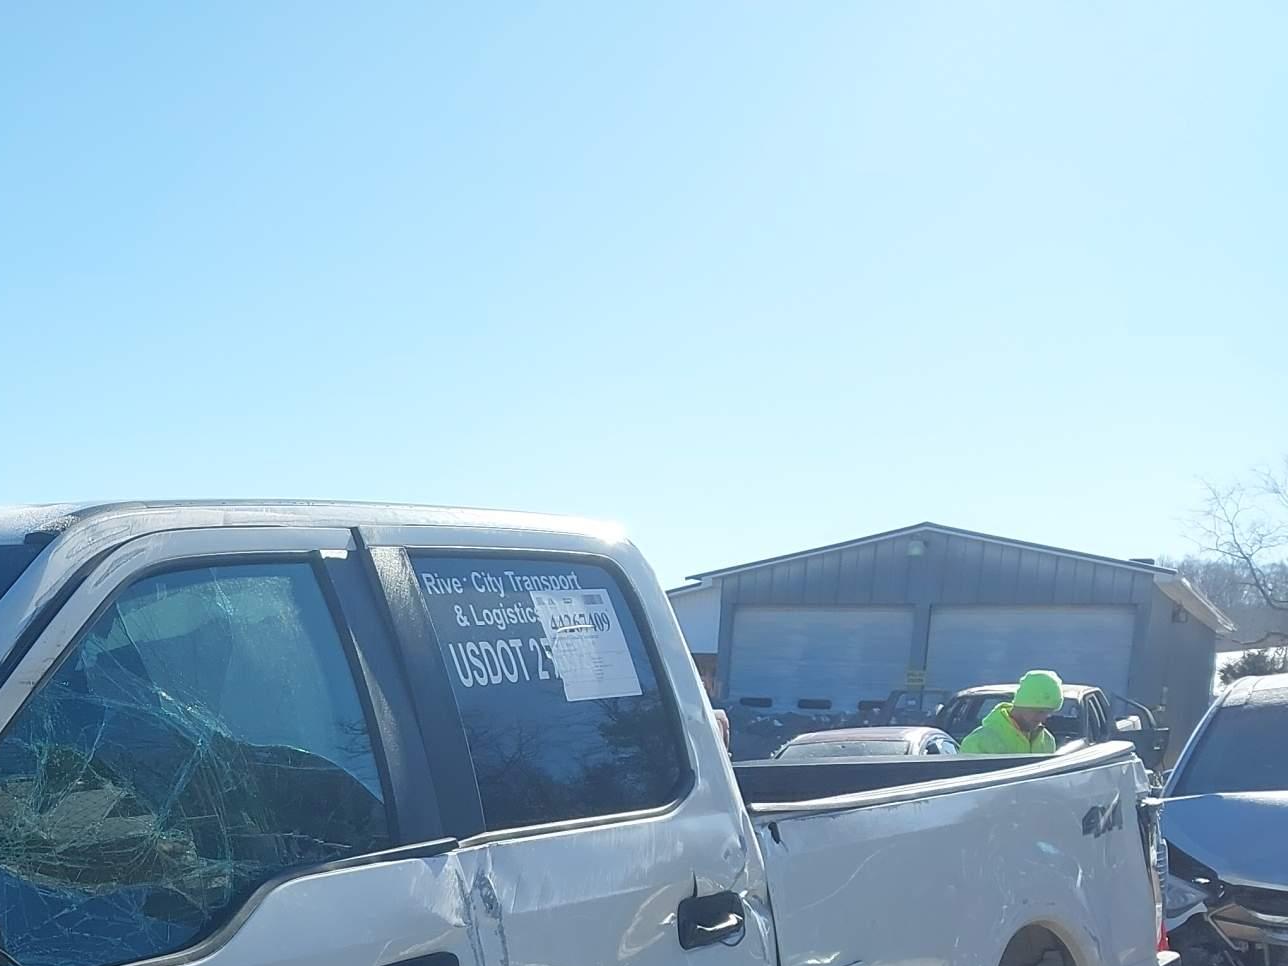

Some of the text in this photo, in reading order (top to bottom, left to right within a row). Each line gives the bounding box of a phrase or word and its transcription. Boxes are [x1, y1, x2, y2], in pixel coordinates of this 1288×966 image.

[421, 570, 581, 598] Rive City Transport
[454, 604, 470, 627] &
[448, 638, 530, 688] USDOT
